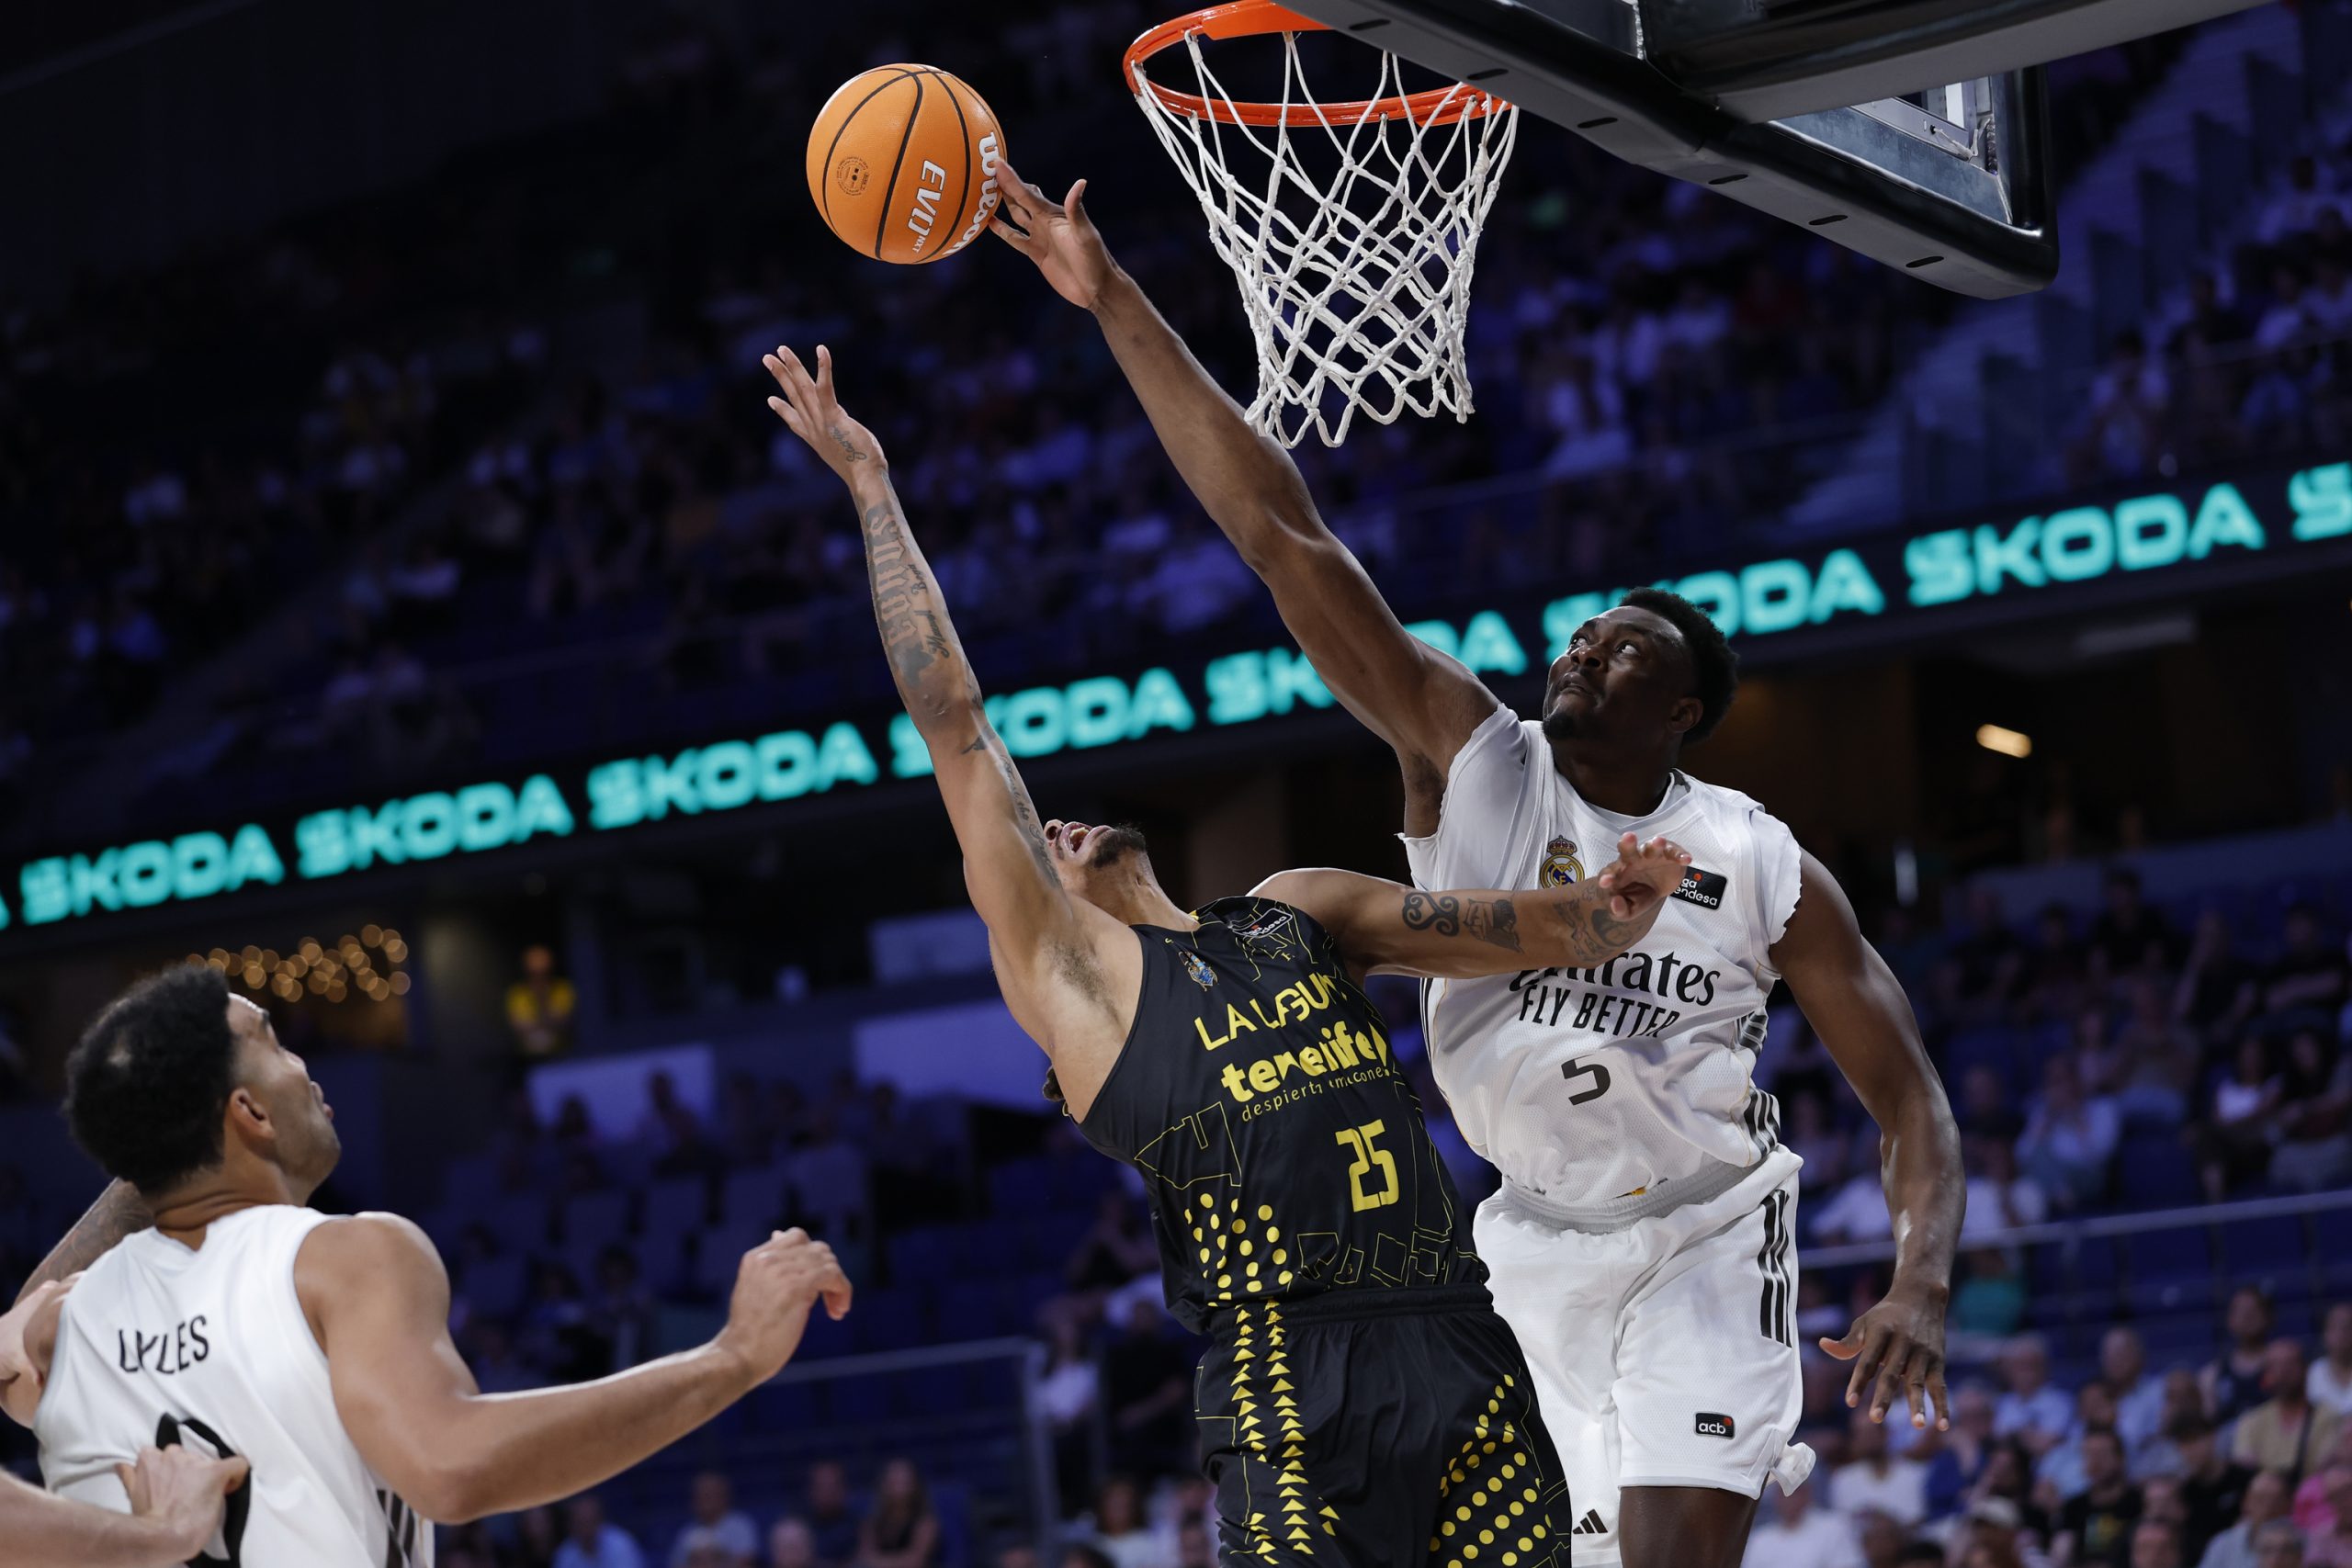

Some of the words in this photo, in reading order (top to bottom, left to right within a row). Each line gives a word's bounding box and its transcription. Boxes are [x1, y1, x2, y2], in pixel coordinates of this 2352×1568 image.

[908, 159, 946, 237] EVO
[1194, 1003, 1259, 1052] LA
[1519, 984, 1571, 1027] FLY
[1572, 992, 1680, 1039] BETTER
[1335, 1119, 1399, 1213] 25
[118, 1314, 209, 1375] LYLES
[1698, 1422, 1726, 1435] acb
